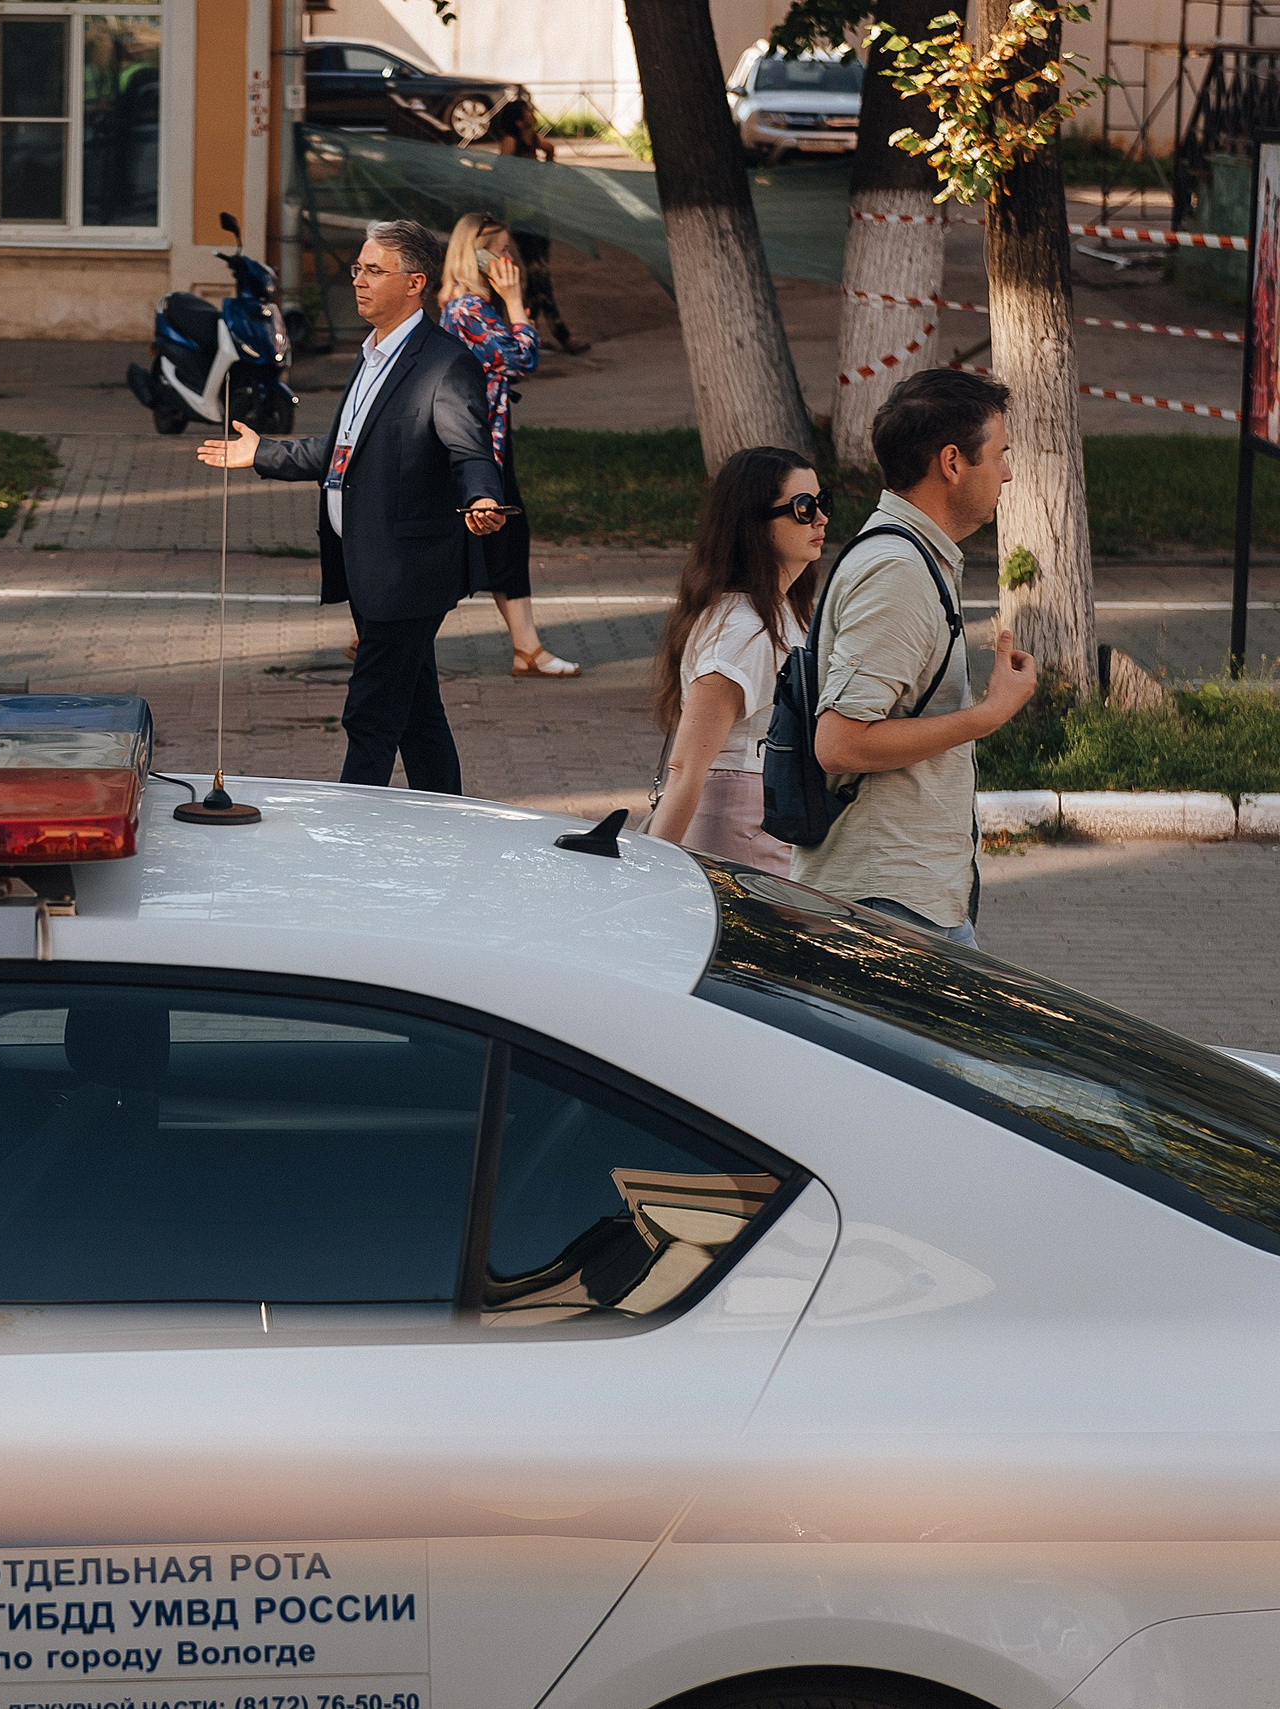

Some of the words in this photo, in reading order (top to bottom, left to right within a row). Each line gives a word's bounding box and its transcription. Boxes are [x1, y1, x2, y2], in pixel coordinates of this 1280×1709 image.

[230, 1552, 332, 1582] РОТА
[129, 1597, 240, 1631] УМВД
[254, 1593, 416, 1624] РОССИИ
[46, 1647, 163, 1674] городу
[176, 1640, 316, 1668] Вологде
[317, 1693, 420, 1709] 76-50-50
